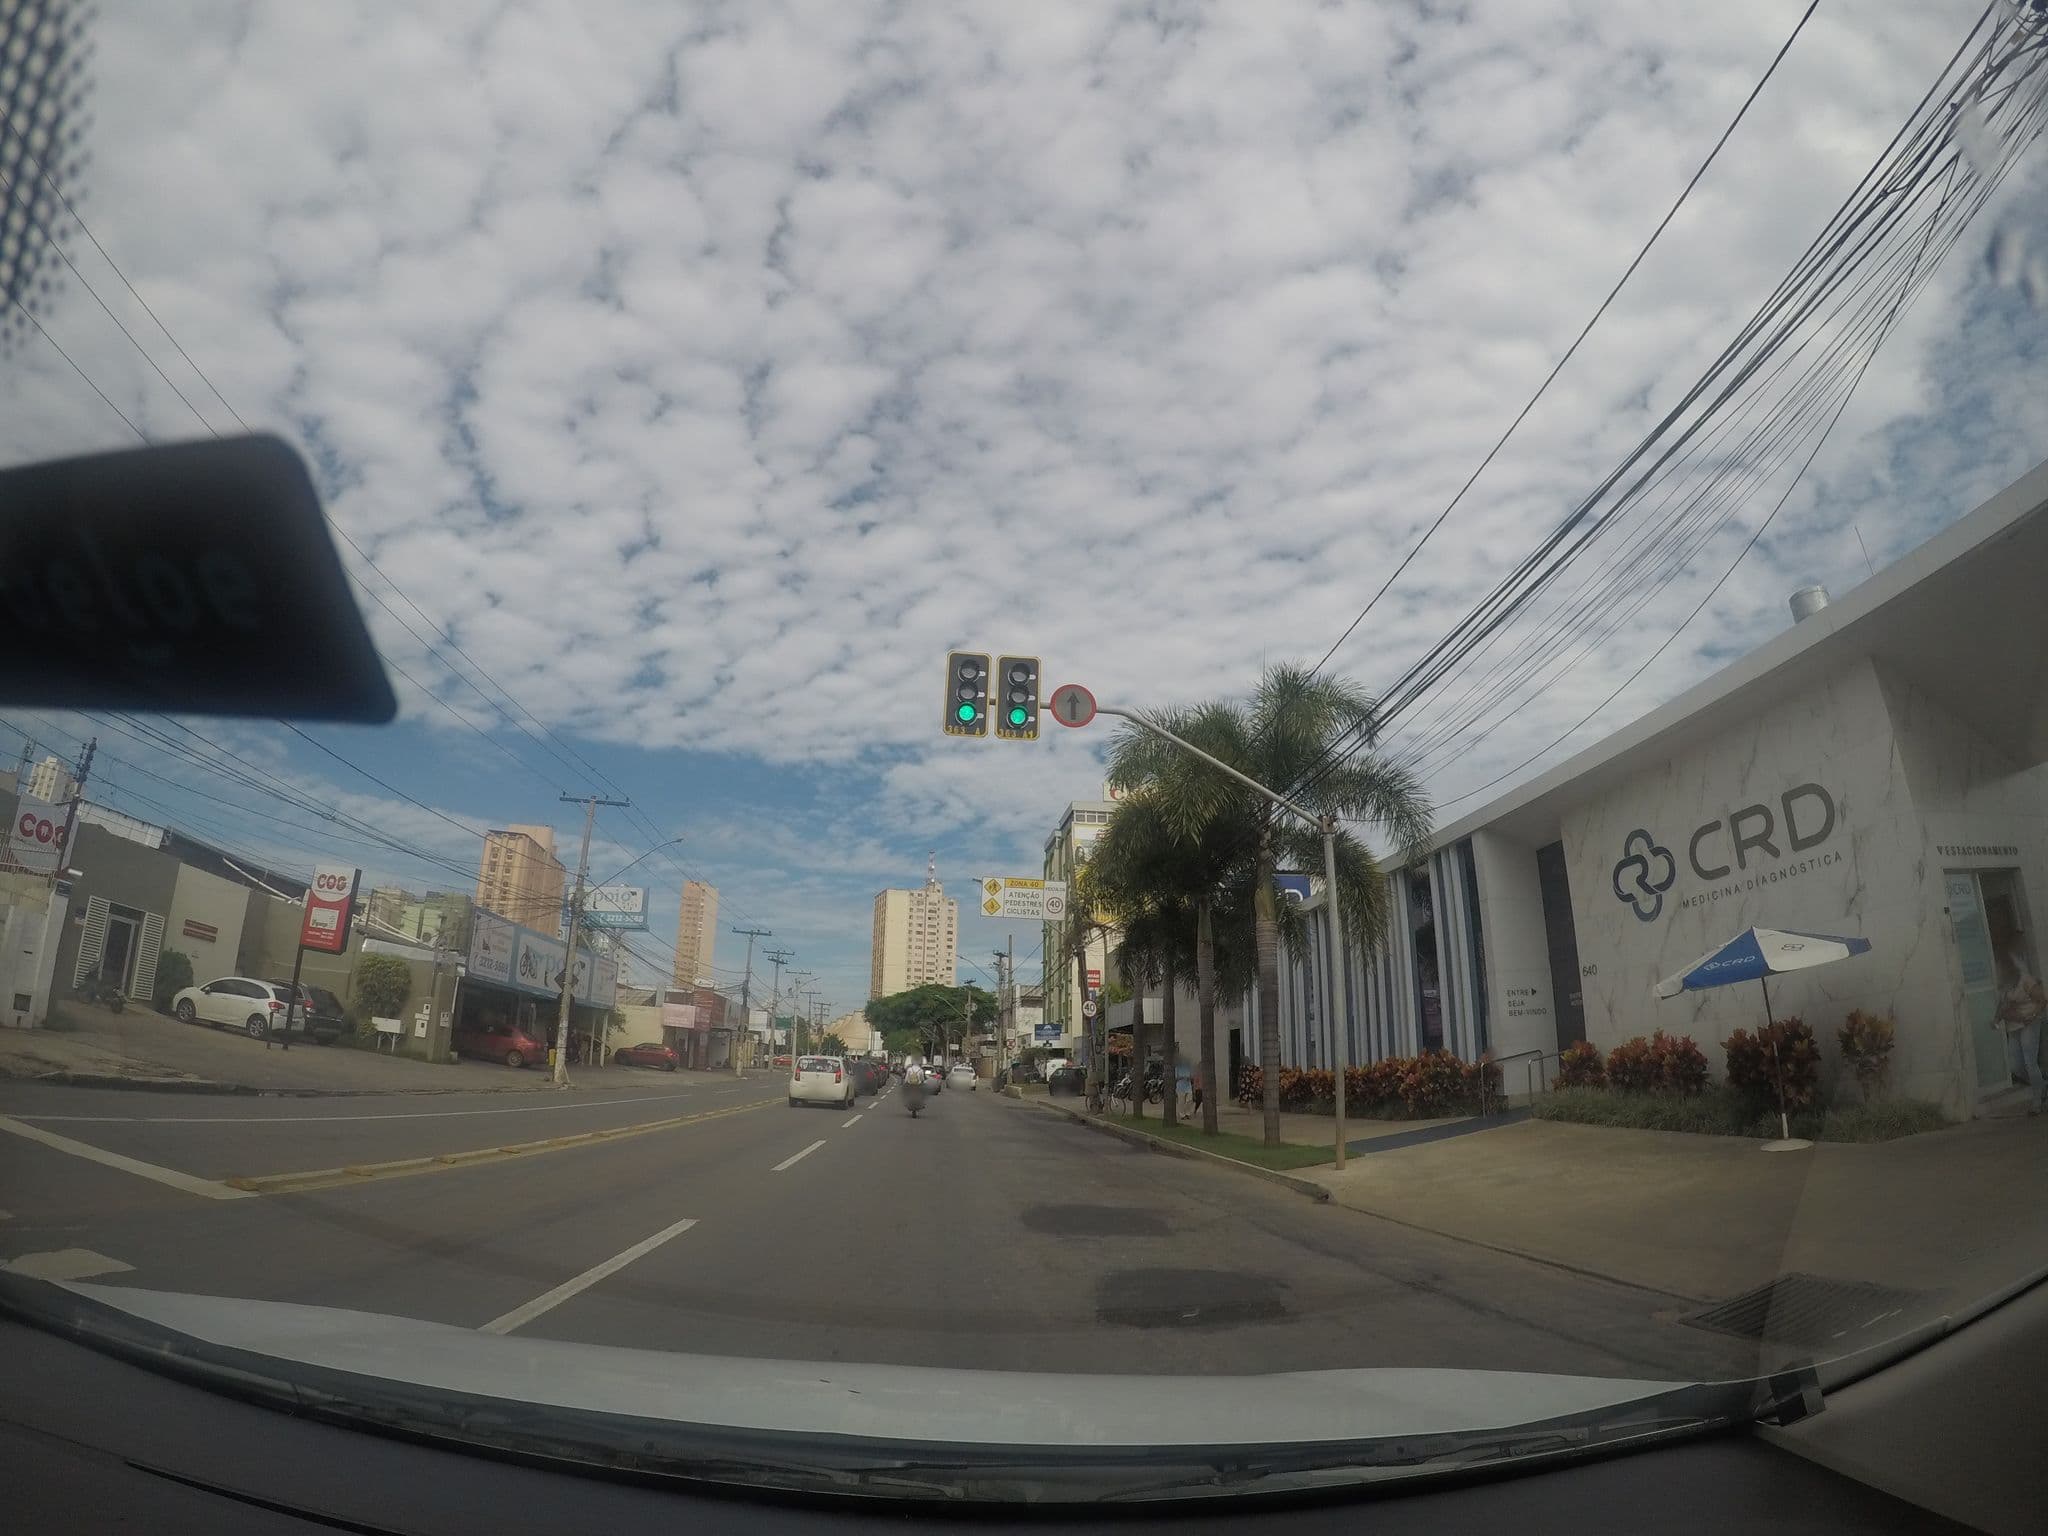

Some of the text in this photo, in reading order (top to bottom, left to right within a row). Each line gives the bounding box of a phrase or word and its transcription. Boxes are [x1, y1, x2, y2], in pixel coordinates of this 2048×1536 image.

[1689, 782, 1835, 881] CRD
[317, 873, 348, 891] COG
[1683, 850, 1843, 909] MEDICINA DIAGNÓSTICA
[1008, 890, 1040, 899] ATENÇÃO
[1005, 899, 1042, 908] PEDESTRES
[1050, 900, 1060, 908] 40
[1006, 908, 1040, 916] CICLISTAS
[1722, 955, 1755, 967] CRD
[1582, 964, 1598, 977] 640
[1507, 988, 1529, 997] ENTRE
[1084, 1003, 1095, 1012] 40
